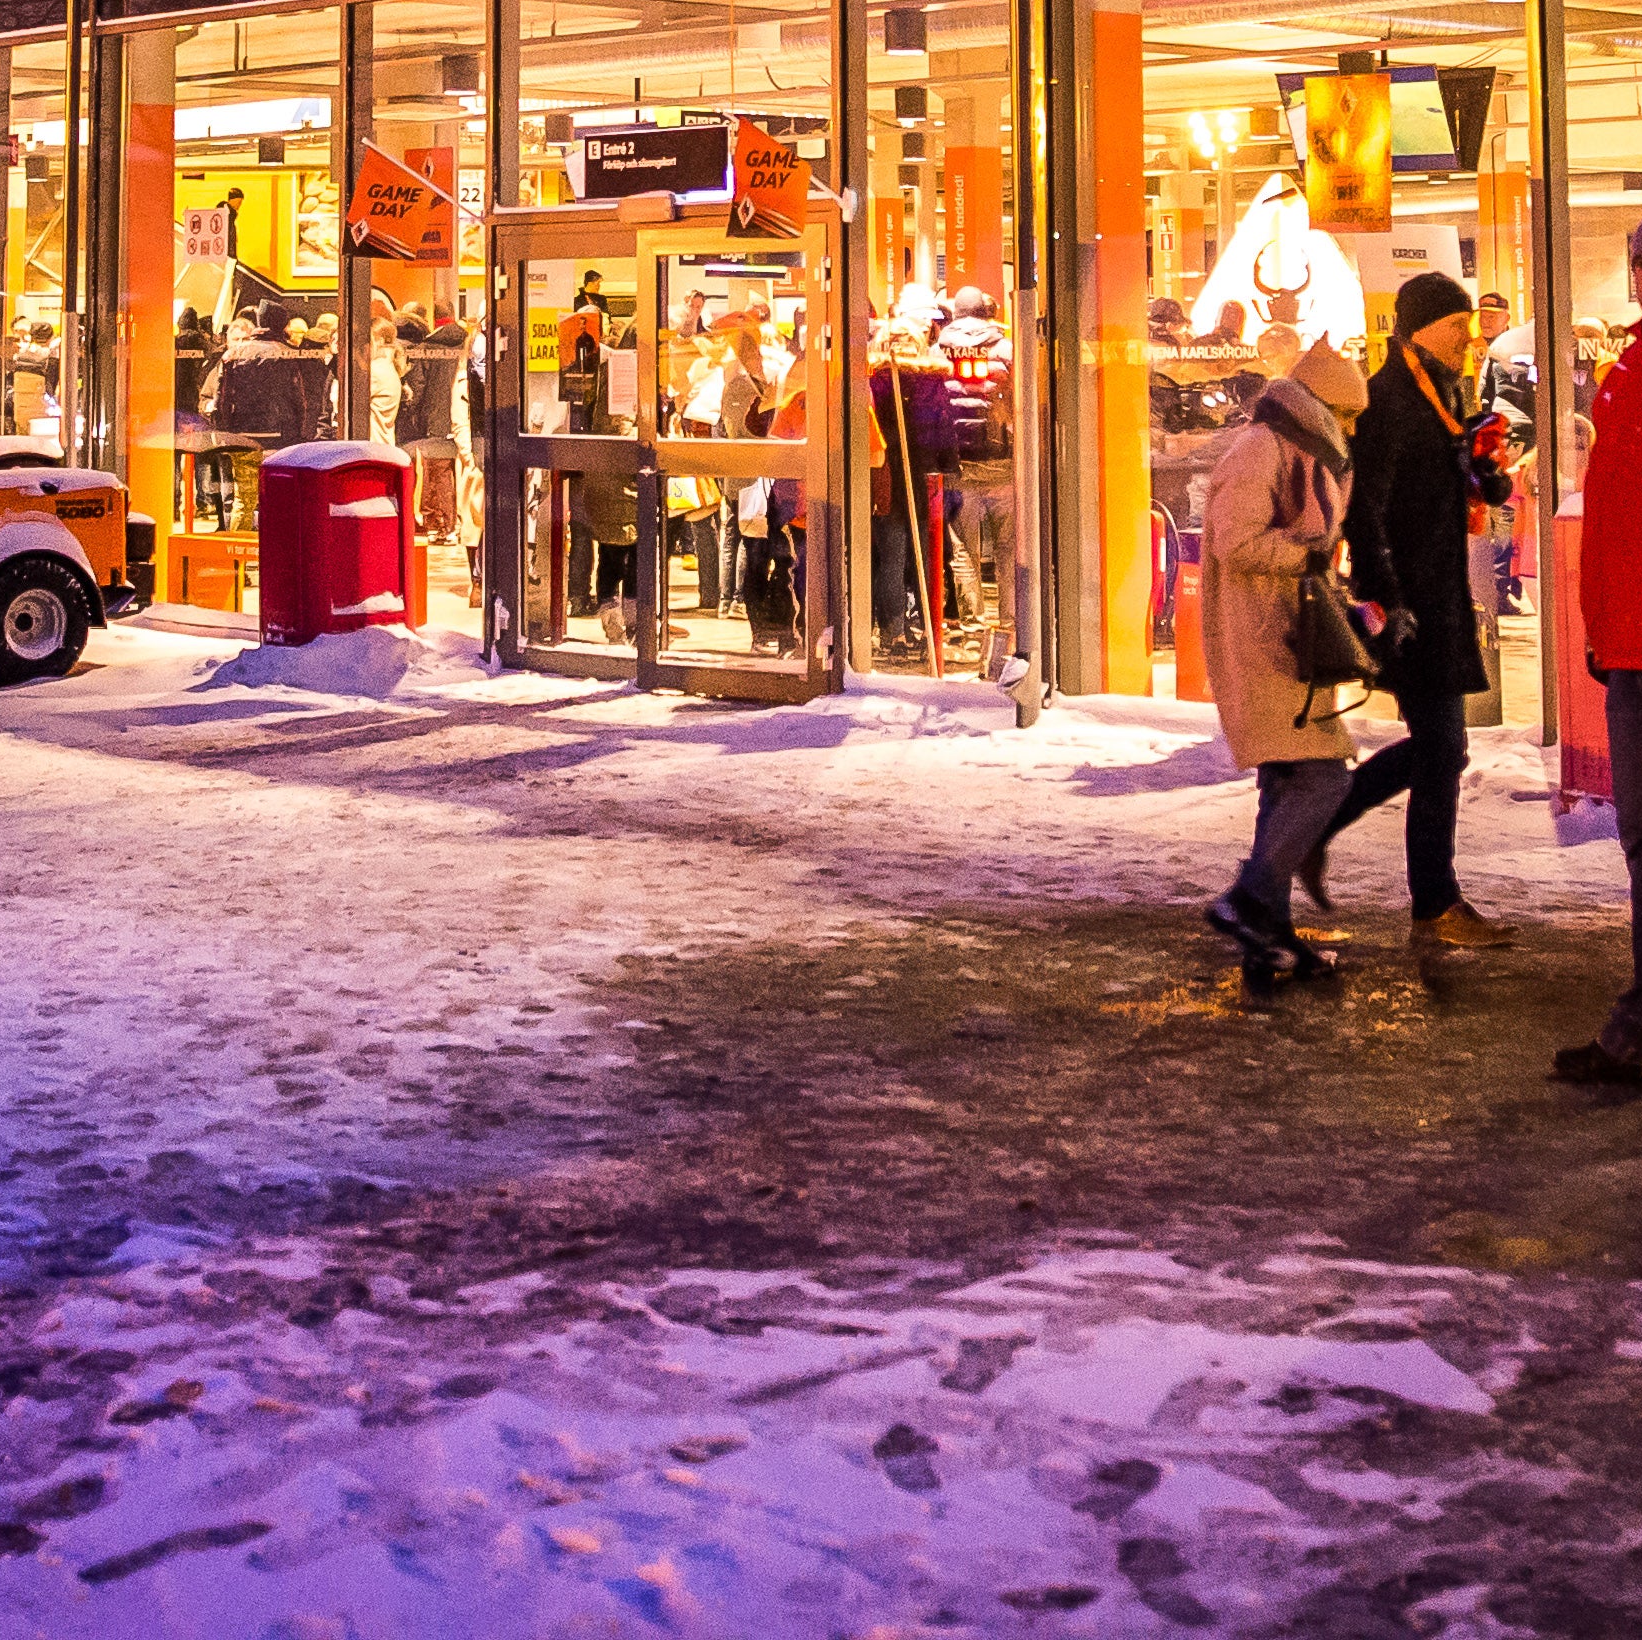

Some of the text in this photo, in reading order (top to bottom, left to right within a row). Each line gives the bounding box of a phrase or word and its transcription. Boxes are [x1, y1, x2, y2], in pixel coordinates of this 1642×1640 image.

[603, 142, 627, 156] Entré
[628, 141, 635, 155] 2
[745, 149, 799, 170] GAME
[750, 171, 791, 189] DAY
[367, 183, 424, 203] GAME
[460, 187, 481, 203] 22
[369, 201, 414, 219] DAY
[1180, 345, 1260, 359] KARLSKRONA
